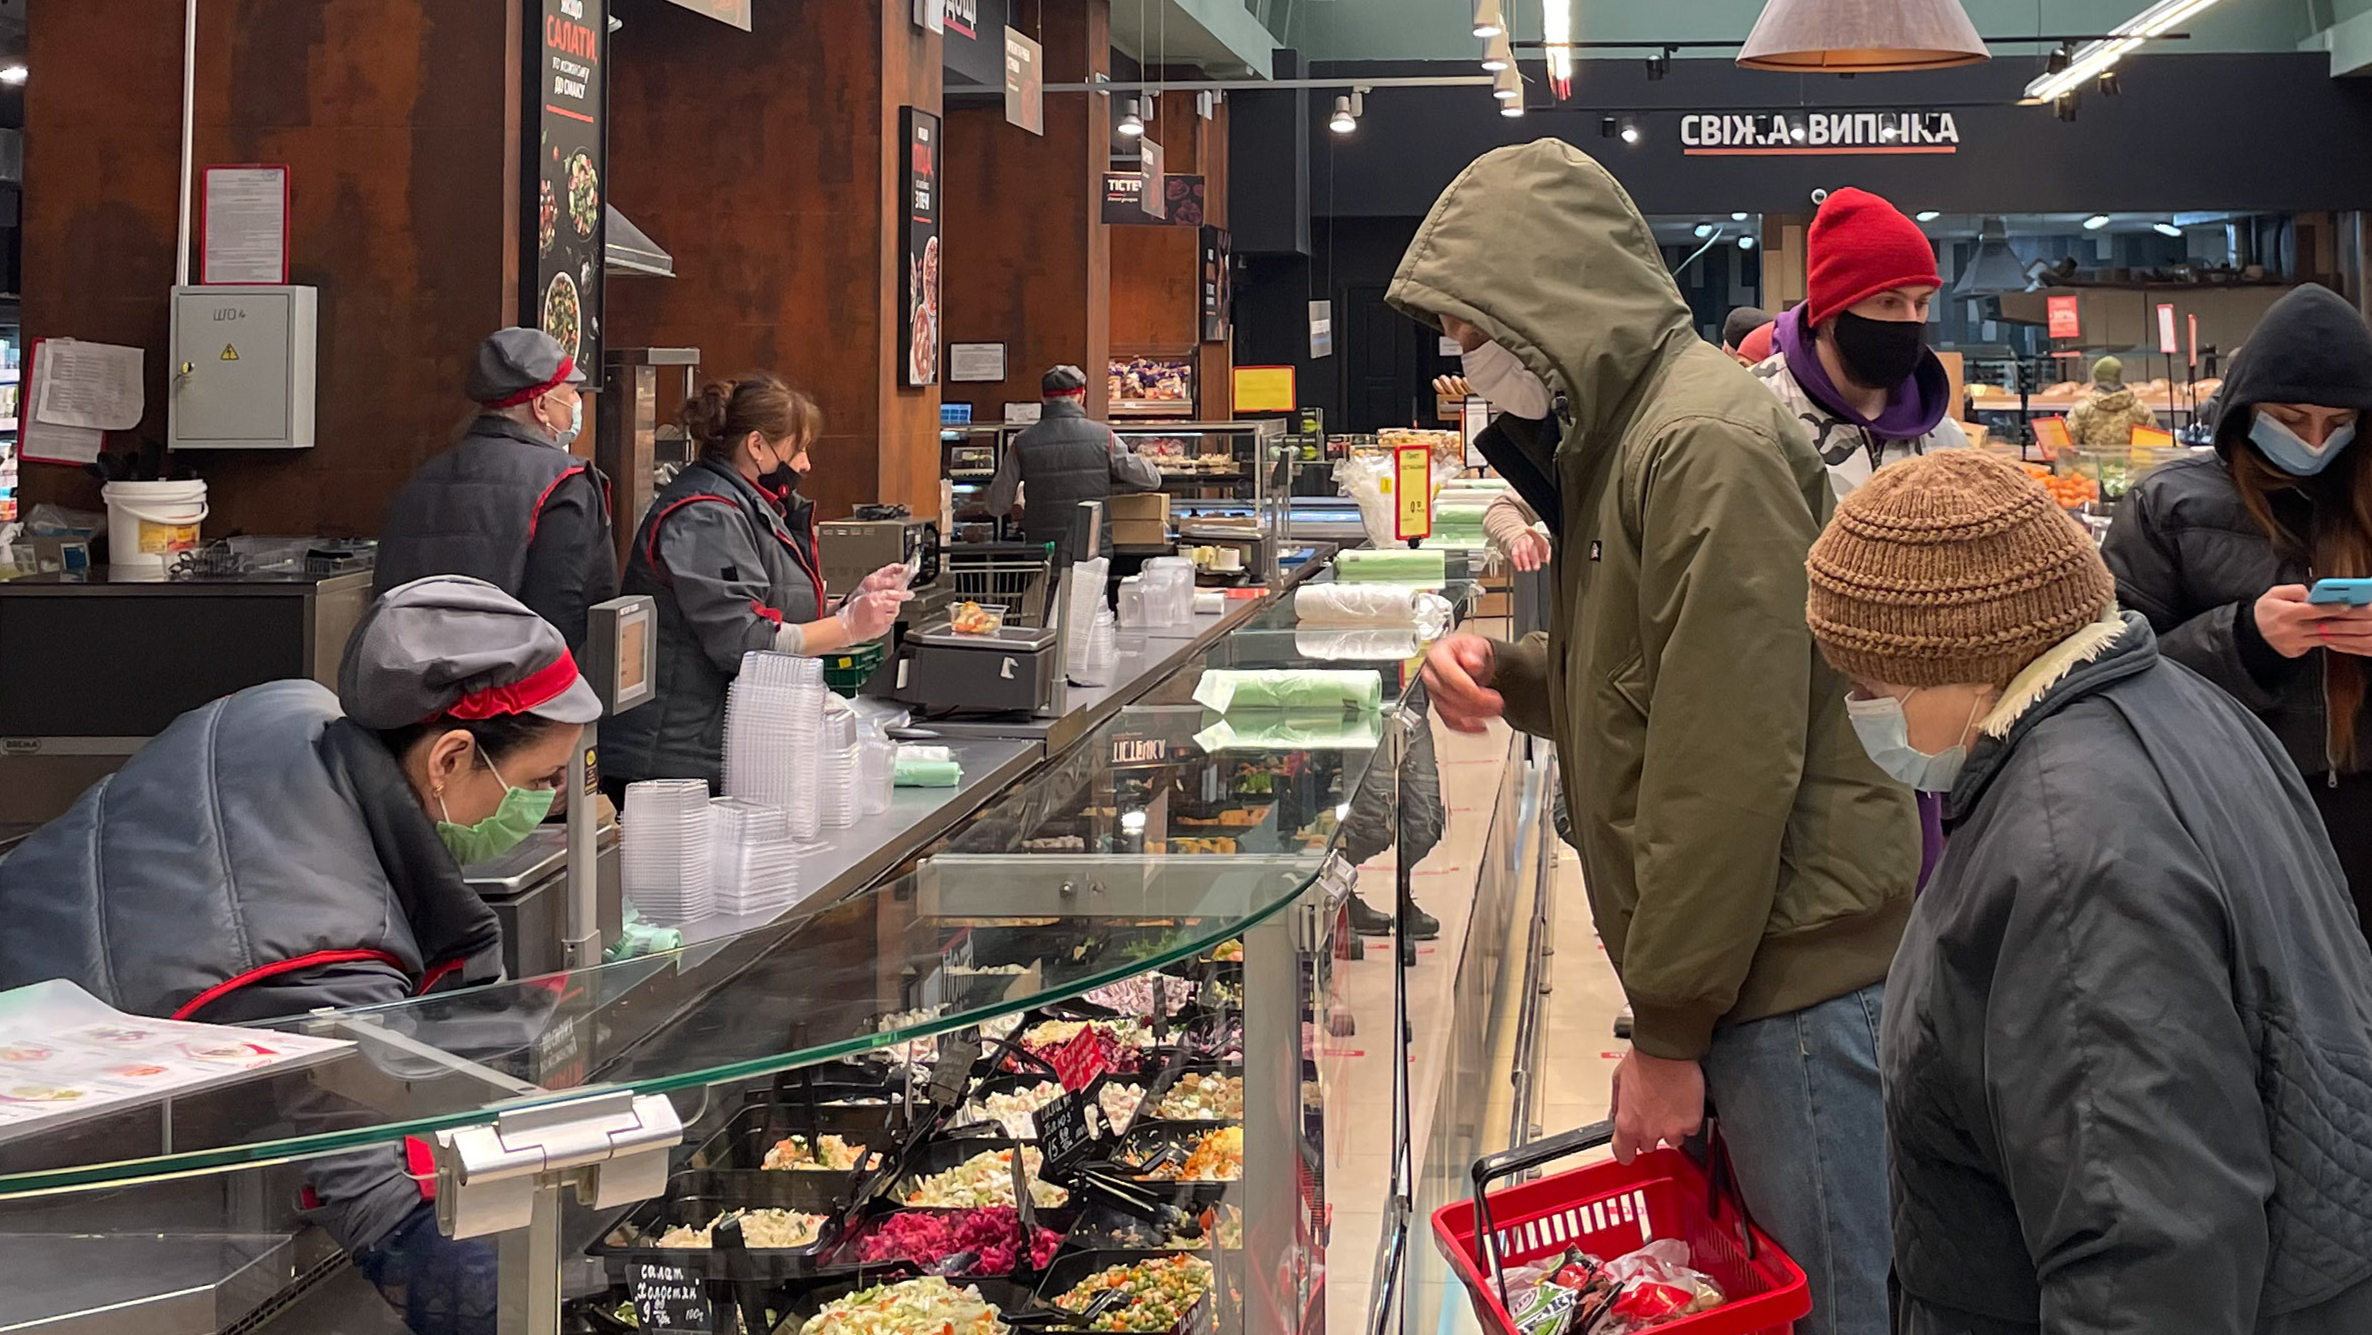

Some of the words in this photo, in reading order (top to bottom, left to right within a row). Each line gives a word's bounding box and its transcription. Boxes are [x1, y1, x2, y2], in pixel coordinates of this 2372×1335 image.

[547, 14, 598, 66] САЛАТИ,
[1681, 115, 1791, 145] СВІЖА
[1808, 113, 1959, 144] ВИПІЧКА
